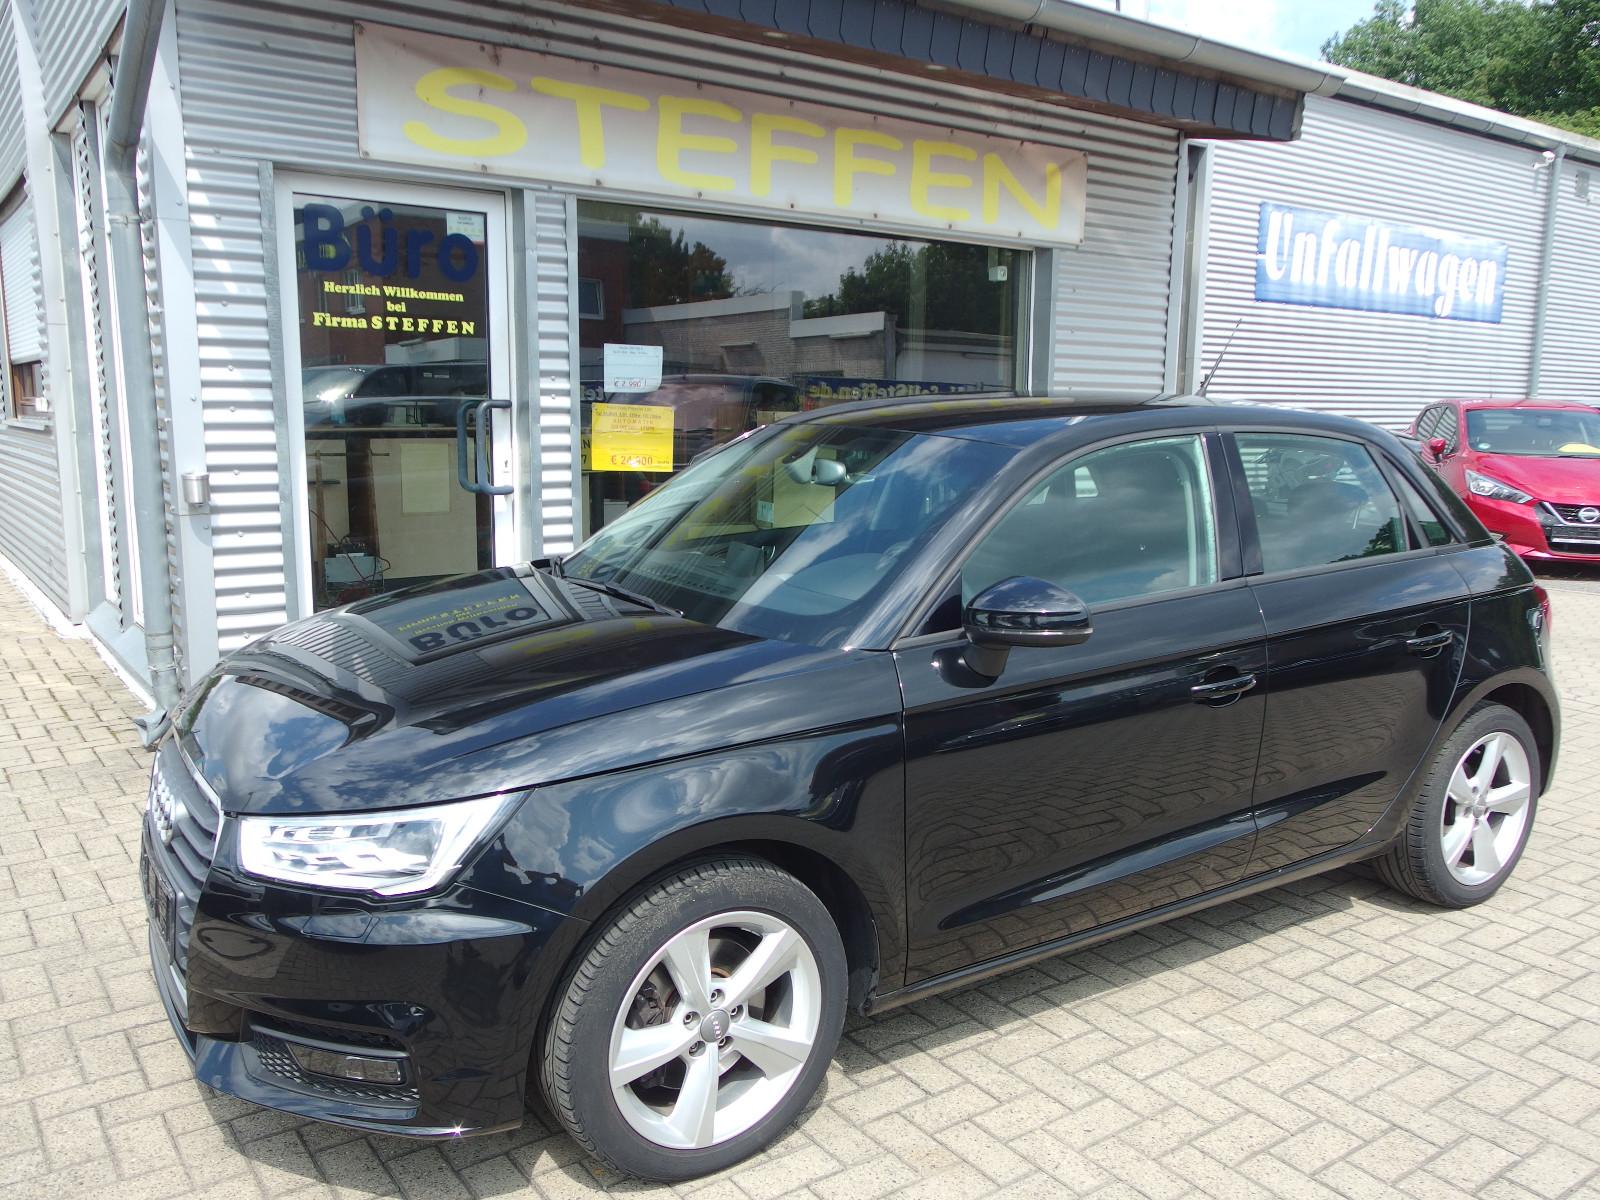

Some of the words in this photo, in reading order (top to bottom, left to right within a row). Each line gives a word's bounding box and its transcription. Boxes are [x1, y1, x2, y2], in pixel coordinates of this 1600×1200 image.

[402, 67, 1062, 230] STEFFEN
[303, 203, 479, 284] Büro
[1257, 209, 1497, 318] Unfallwagen
[323, 281, 381, 297] Herzlich
[383, 285, 464, 303] Willkommen
[386, 300, 407, 313] bei
[312, 311, 368, 329] Firma
[371, 315, 475, 336] STEFFEN
